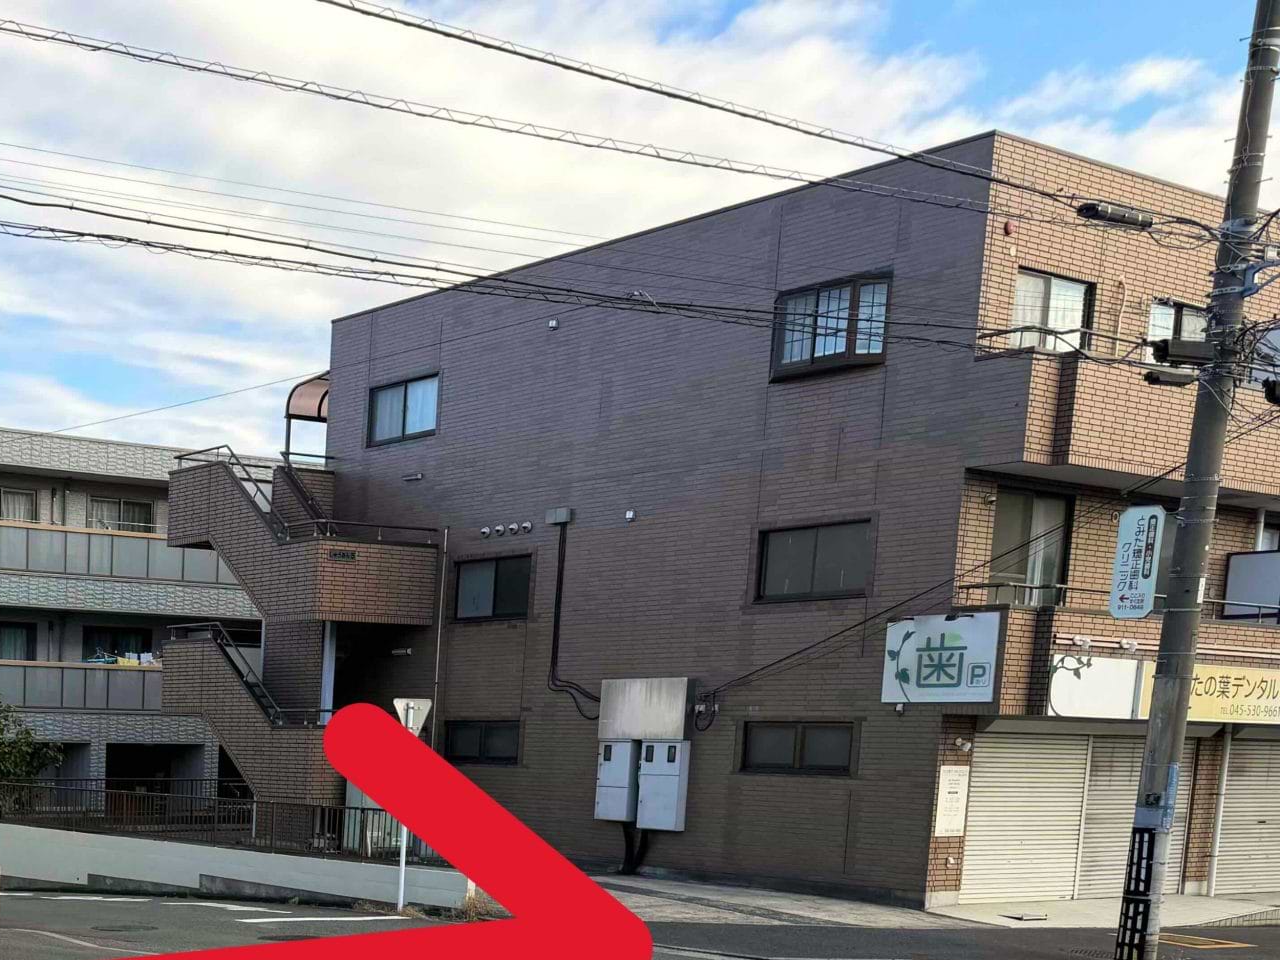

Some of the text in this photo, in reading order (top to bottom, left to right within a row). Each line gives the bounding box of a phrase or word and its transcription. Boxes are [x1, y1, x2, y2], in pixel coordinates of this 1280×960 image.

[1117, 542, 1132, 592] クリニック
[916, 633, 967, 688] 歯
[970, 665, 986, 685] P
